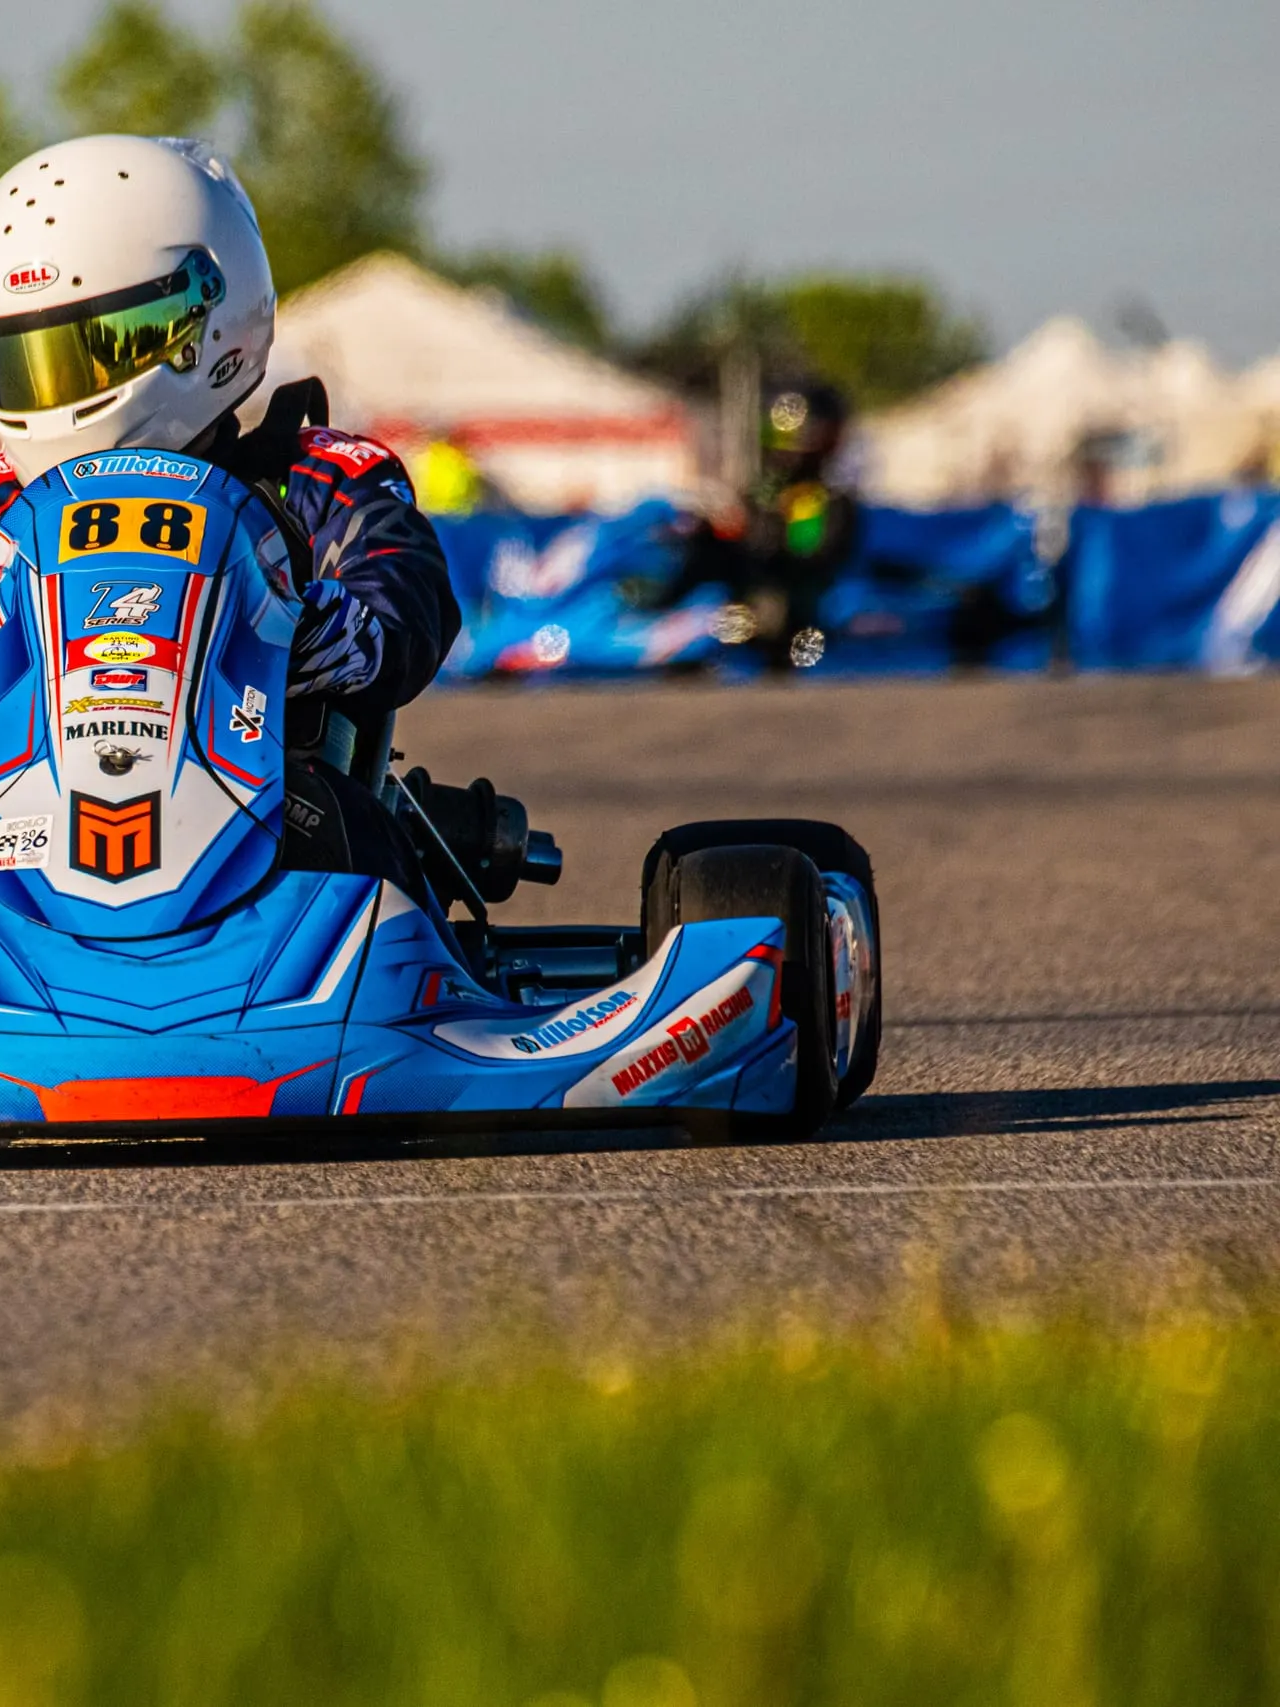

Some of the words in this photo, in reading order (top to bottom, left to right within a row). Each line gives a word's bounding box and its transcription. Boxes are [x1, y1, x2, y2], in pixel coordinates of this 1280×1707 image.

[10, 268, 51, 287] BELL
[98, 456, 197, 477] Tillotson
[69, 503, 192, 551] 88
[85, 616, 143, 629] SERIES
[64, 720, 169, 741] MARLINE
[530, 991, 631, 1049] Tillotson
[611, 1039, 679, 1098] MAXXIS
[700, 984, 755, 1037] RACING
